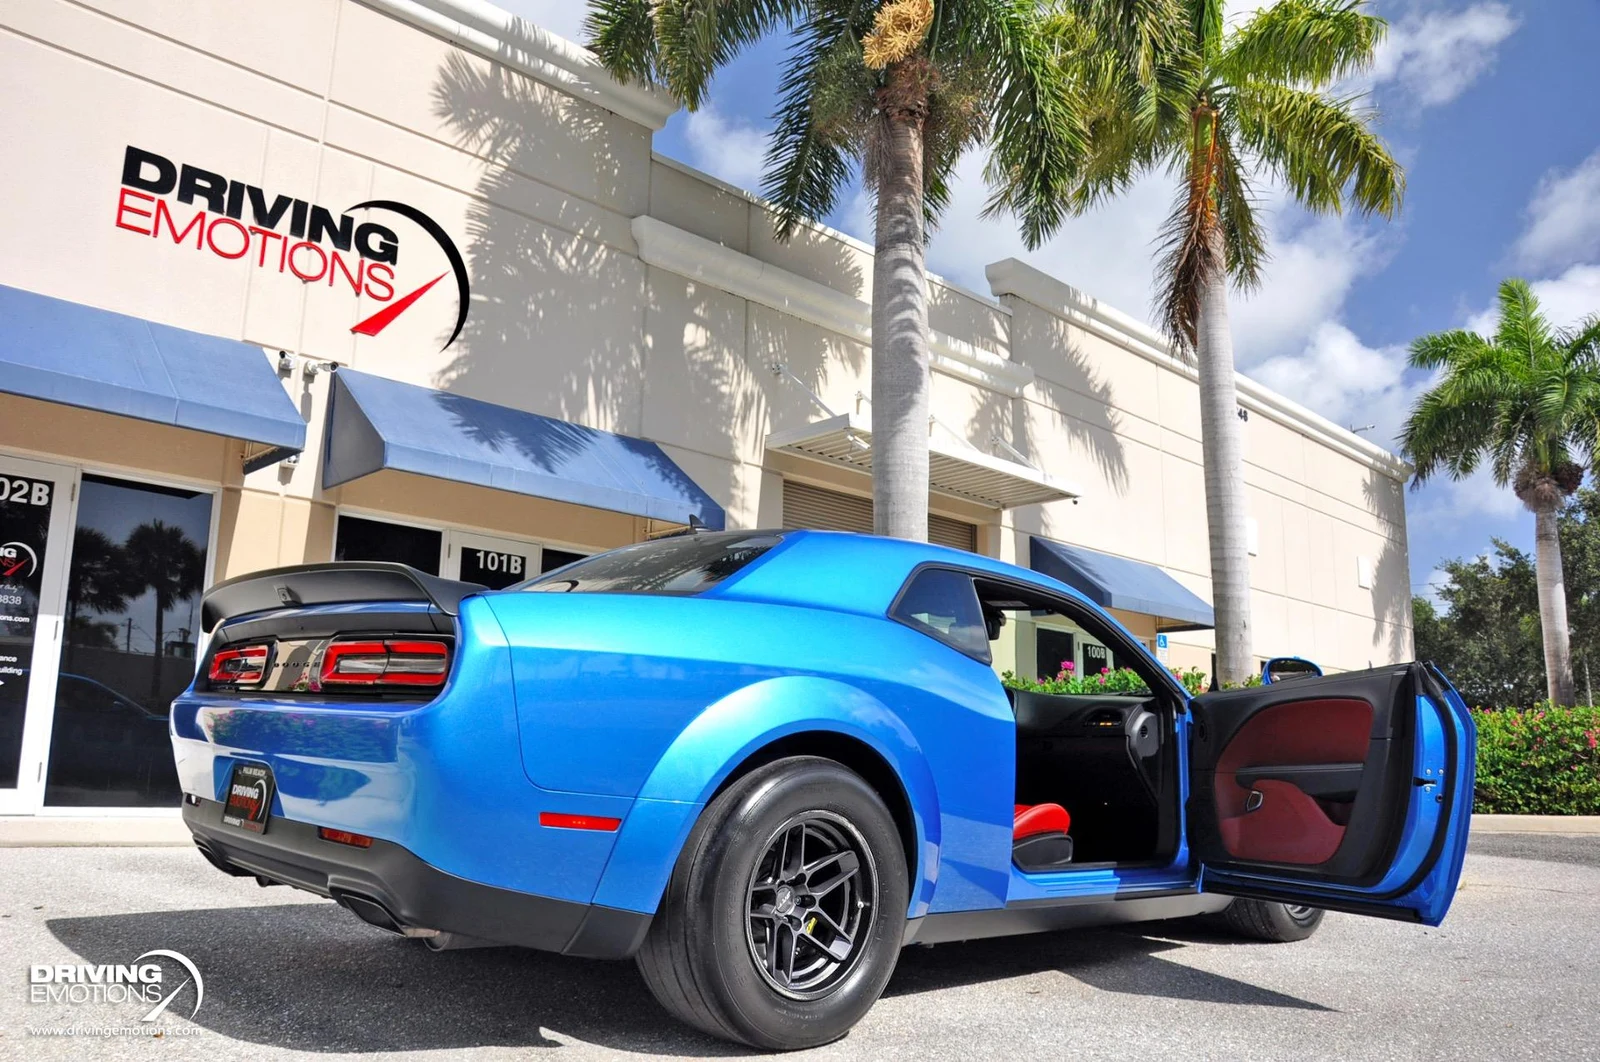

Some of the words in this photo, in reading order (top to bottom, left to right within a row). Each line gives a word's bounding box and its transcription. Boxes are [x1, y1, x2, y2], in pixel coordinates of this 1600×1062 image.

[121, 144, 399, 265] DRIVING
[115, 186, 396, 302] EMOTIONS
[1236, 407, 1249, 422] 48
[476, 551, 522, 573] 101B
[1086, 645, 1106, 660] 100B
[231, 783, 260, 800] DRIVING
